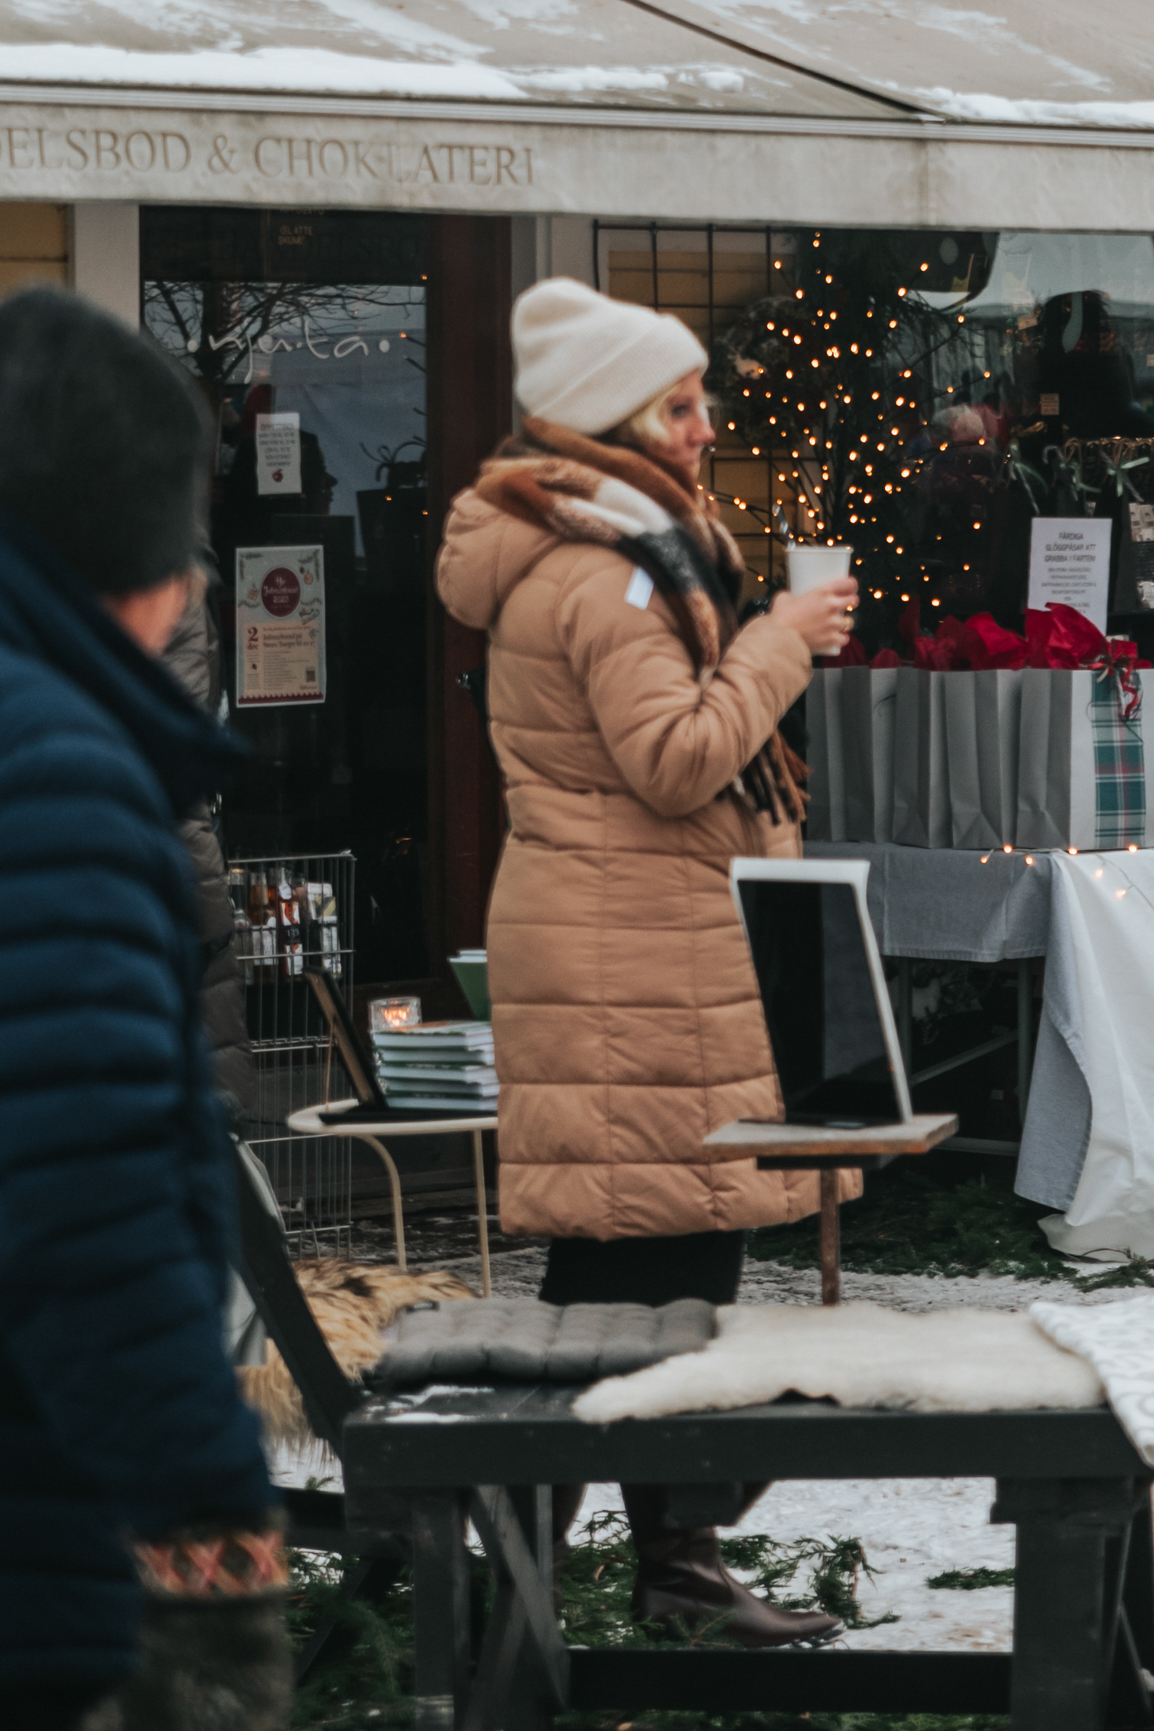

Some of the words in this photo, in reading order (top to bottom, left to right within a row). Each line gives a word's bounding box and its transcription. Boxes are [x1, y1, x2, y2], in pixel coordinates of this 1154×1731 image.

[0, 127, 193, 173] ELSBOD
[207, 134, 241, 175] &
[254, 136, 535, 186] CHOKLATERI
[247, 626, 258, 642] 2
